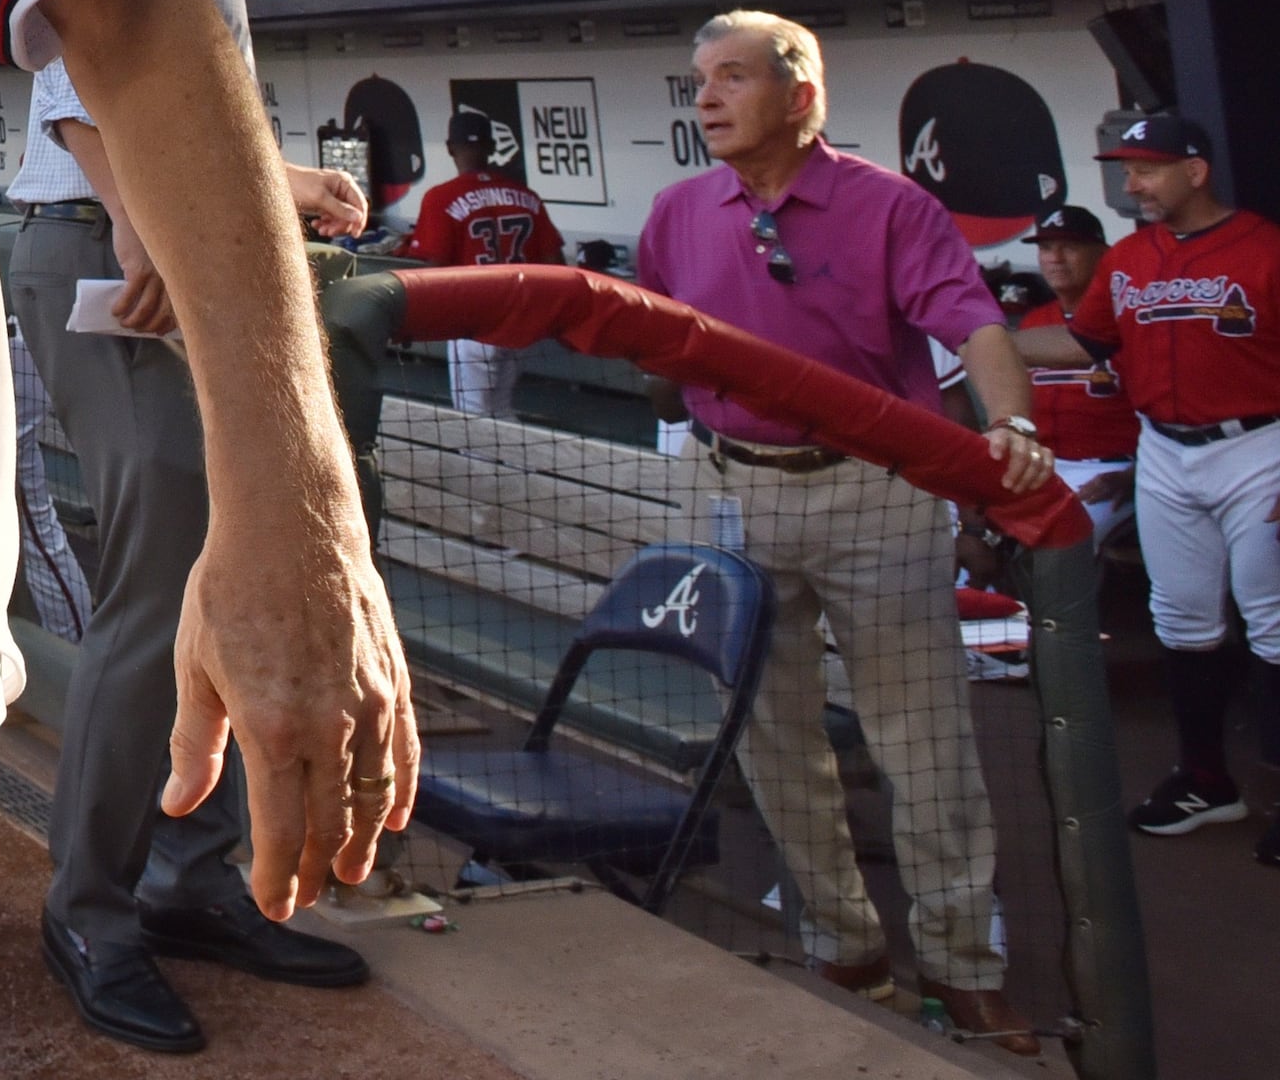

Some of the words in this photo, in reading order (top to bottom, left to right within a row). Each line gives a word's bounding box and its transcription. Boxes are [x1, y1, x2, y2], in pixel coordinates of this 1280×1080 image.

[532, 106, 588, 140] NEW
[537, 143, 593, 177] ERA
[445, 187, 540, 223] WASHINGTON
[468, 213, 534, 266] 37
[1110, 271, 1229, 318] Braves
